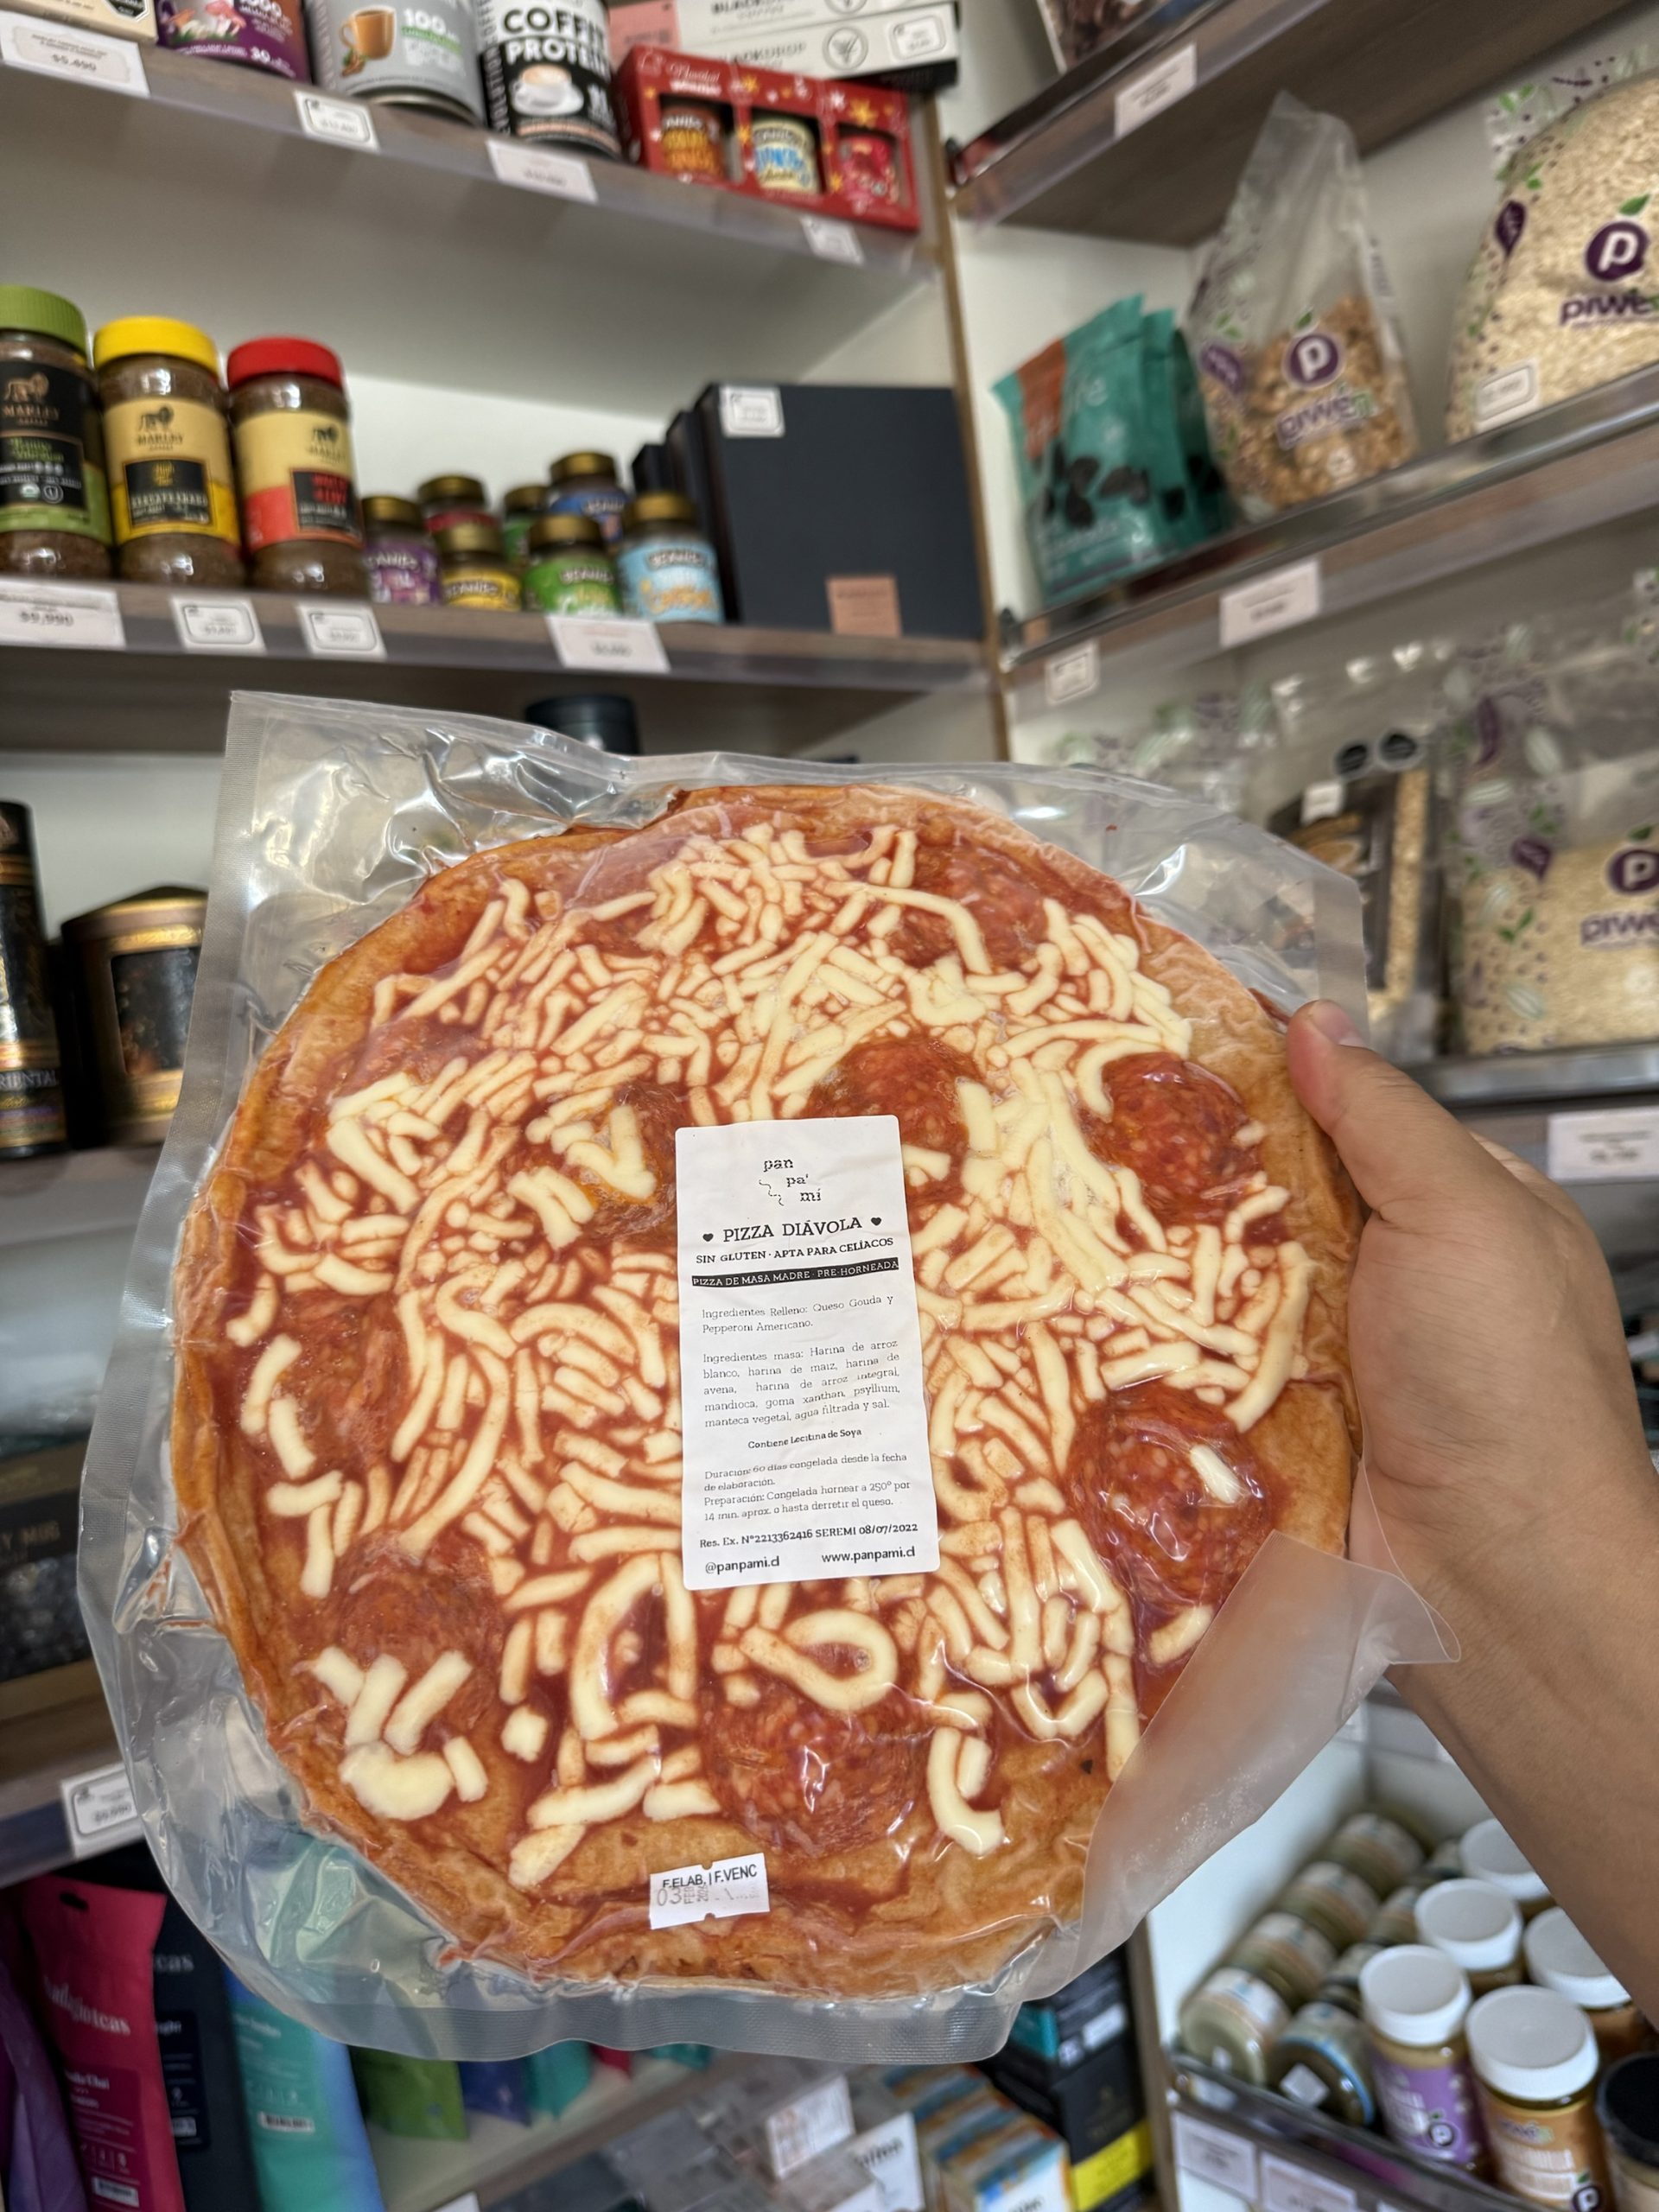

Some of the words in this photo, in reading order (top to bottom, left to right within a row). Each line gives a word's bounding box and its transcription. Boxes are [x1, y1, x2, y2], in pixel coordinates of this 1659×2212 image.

[764, 1159, 794, 1172] pan
[723, 1225, 774, 1243] PIZZA
[782, 1217, 862, 1236] DIÁVOLA
[696, 1255, 715, 1263] SIN
[721, 1250, 766, 1262] GLUTEN
[774, 1249, 804, 1259] APTA
[807, 1246, 836, 1256] PARA
[839, 1237, 893, 1253] CELÍACOS
[693, 1277, 723, 1286] PIZZA
[726, 1276, 740, 1285] DE
[742, 1274, 771, 1284] MASA
[773, 1271, 810, 1281] MADRE
[702, 1308, 766, 1320] Ingredientes
[771, 1306, 808, 1317] Relleno:
[813, 1301, 844, 1312] Queso
[849, 1296, 881, 1306] Gouda
[702, 1322, 753, 1335] Pepperoni
[756, 1319, 813, 1332] Americano.
[702, 1351, 767, 1364] Ingredientes
[773, 1351, 804, 1360] masa:
[810, 1344, 845, 1356] Harina
[852, 1343, 864, 1351] de
[870, 1339, 899, 1350] arroz
[703, 1369, 740, 1379] blanco,
[748, 1366, 781, 1376] harina
[790, 1364, 803, 1374] de
[846, 1357, 879, 1369] harina
[887, 1352, 899, 1361] de
[703, 1385, 737, 1395] avena,
[756, 1381, 790, 1391] harina
[800, 1378, 812, 1389] de
[822, 1376, 849, 1386] arroz
[857, 1368, 899, 1380] integral,
[704, 1400, 758, 1411] mandioca,
[766, 1397, 795, 1408] goma
[803, 1391, 846, 1404] xanthan,
[854, 1383, 900, 1396] psyllium,
[705, 1415, 749, 1427] manteca
[753, 1413, 792, 1424] vegetal,
[795, 1408, 819, 1420] agua
[822, 1401, 860, 1414] filtrada
[862, 1402, 869, 1411] y
[872, 1399, 889, 1409] sal.
[748, 1437, 789, 1449] Contiene
[791, 1432, 826, 1444] Lecitina
[828, 1430, 838, 1439] de
[840, 1428, 862, 1438] Soya
[705, 1467, 752, 1479] Duración:
[790, 1456, 838, 1469] congelada
[841, 1454, 869, 1464] desde
[871, 1453, 880, 1462] la
[881, 1452, 907, 1462] fecha
[704, 1493, 765, 1508] Preparación:
[766, 1488, 818, 1502] Congelada
[821, 1483, 858, 1494] hornear
[894, 1481, 911, 1492] por
[718, 1477, 775, 1491] elaboración.
[718, 1510, 741, 1520] min.
[741, 1506, 771, 1519] aprox.
[782, 1503, 809, 1512] hasta
[811, 1499, 850, 1510] derretir
[851, 1498, 860, 1508] el
[862, 1498, 893, 1510] queso.
[700, 1539, 720, 1548] Res.
[722, 1537, 739, 1546] Ex.
[815, 1527, 856, 1537] SEREMI
[859, 1523, 918, 1535] 08/07/2022
[705, 1556, 779, 1574] @panpami.cl
[822, 1546, 915, 1564] www.panpami.cl
[663, 1874, 706, 1888] F.ELAB.
[715, 1864, 757, 1883] F.VENC
